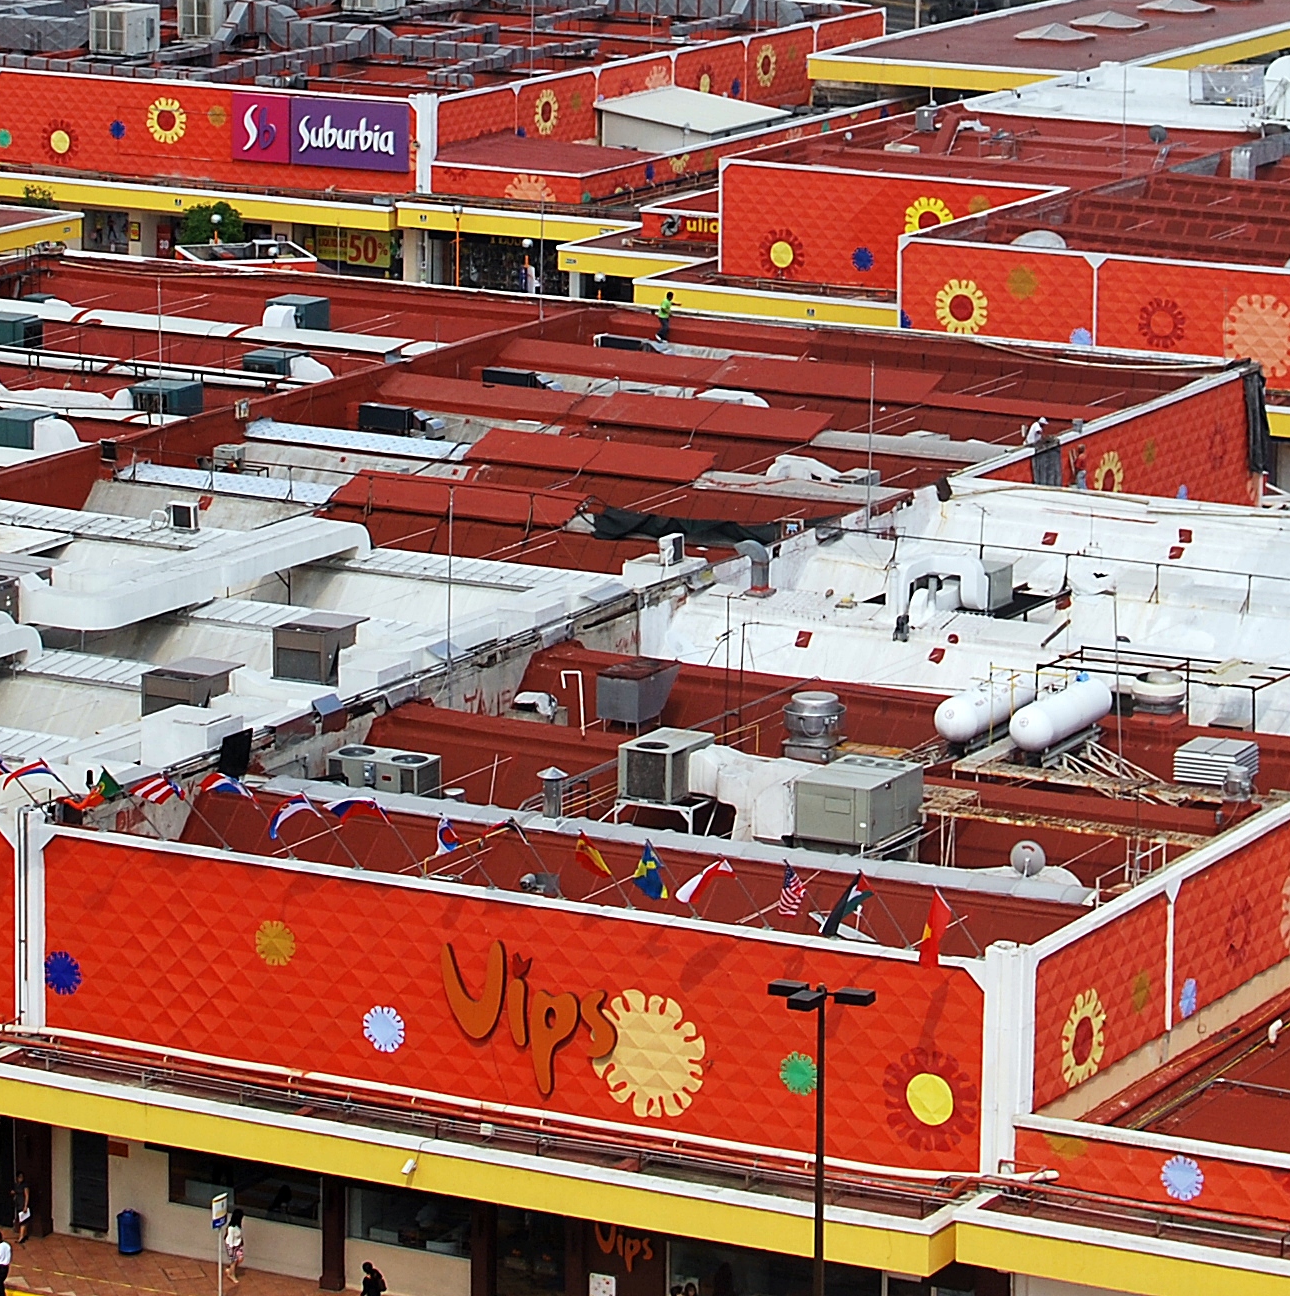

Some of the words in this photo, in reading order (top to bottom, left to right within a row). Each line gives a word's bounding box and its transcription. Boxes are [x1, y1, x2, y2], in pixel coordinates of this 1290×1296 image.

[298, 115, 396, 155] Suburbia
[348, 235, 388, 264] 50%
[441, 940, 617, 1096] Vips
[594, 1223, 653, 1273] Vips
